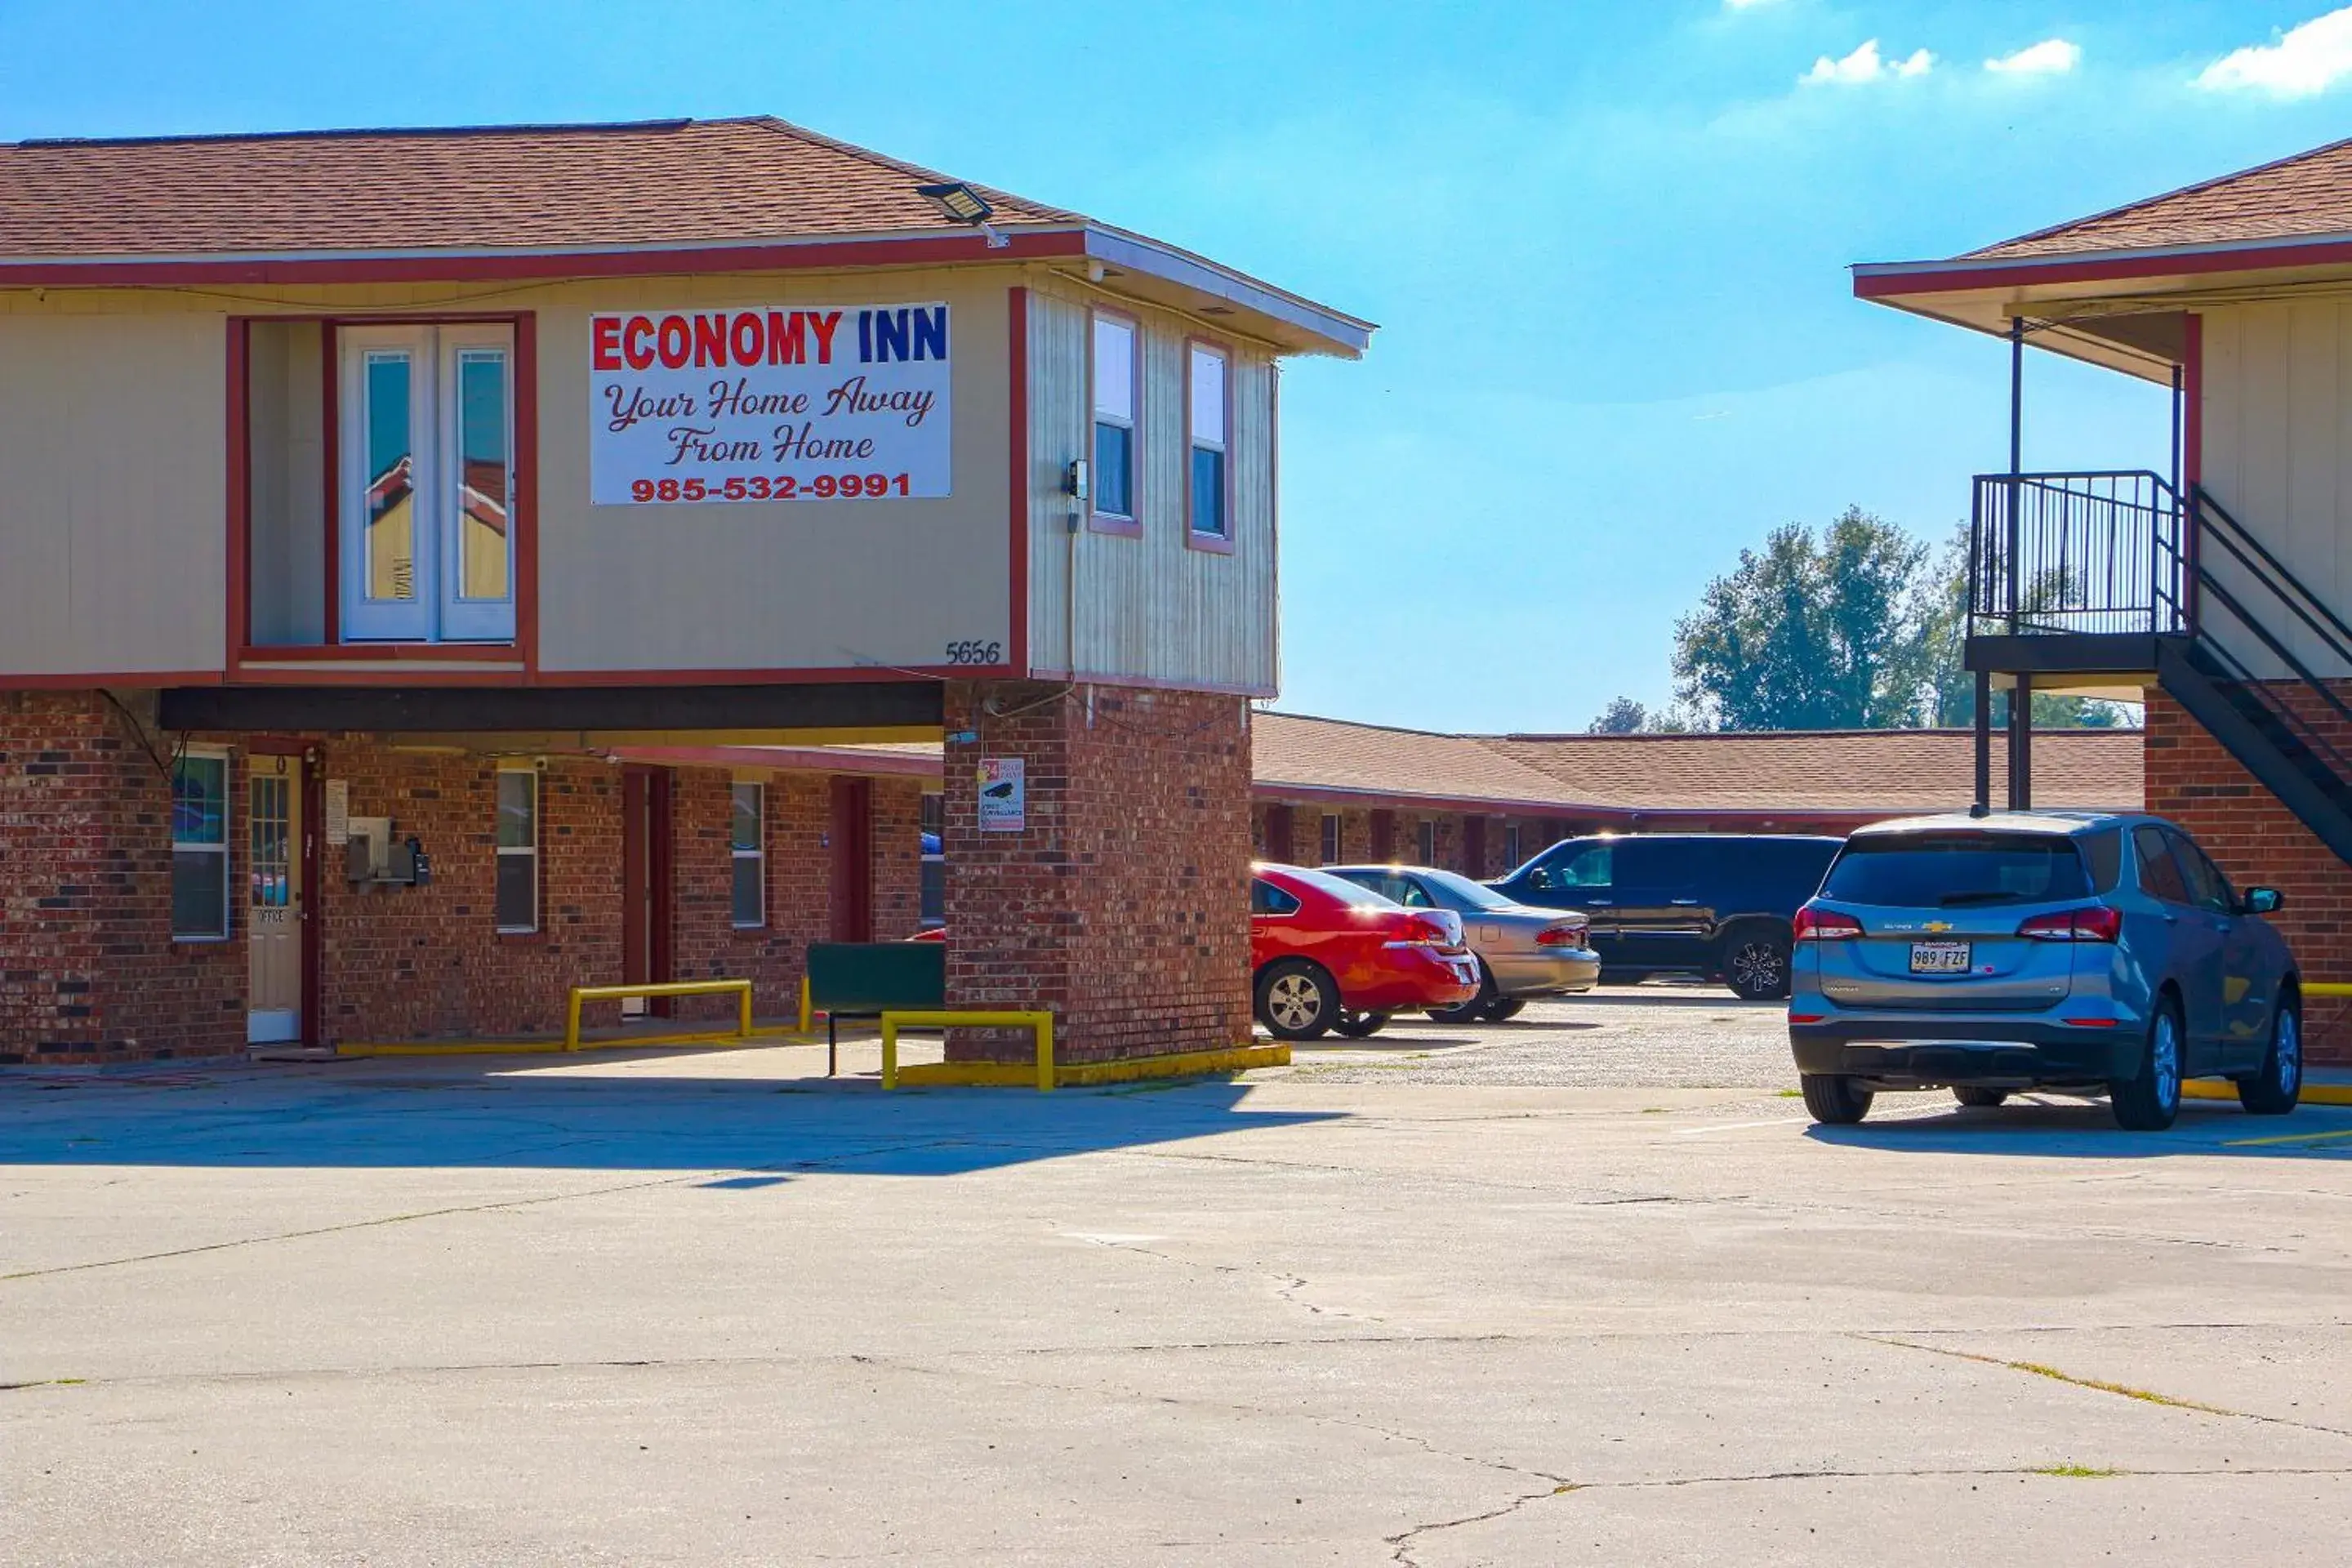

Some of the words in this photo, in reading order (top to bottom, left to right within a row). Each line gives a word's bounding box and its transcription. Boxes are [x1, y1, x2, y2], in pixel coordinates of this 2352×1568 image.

[593, 311, 843, 371] ECONOMY
[858, 307, 947, 363] INN
[604, 384, 697, 432] Your
[708, 377, 809, 418] Home
[822, 376, 935, 427] Away
[664, 425, 762, 465] From
[773, 421, 875, 463] Home
[631, 472, 910, 503] 985-532-9991
[946, 639, 1001, 664] 5656
[258, 909, 284, 923] OFFICE
[1913, 951, 1937, 965] 989
[1945, 951, 1967, 965] FZF
